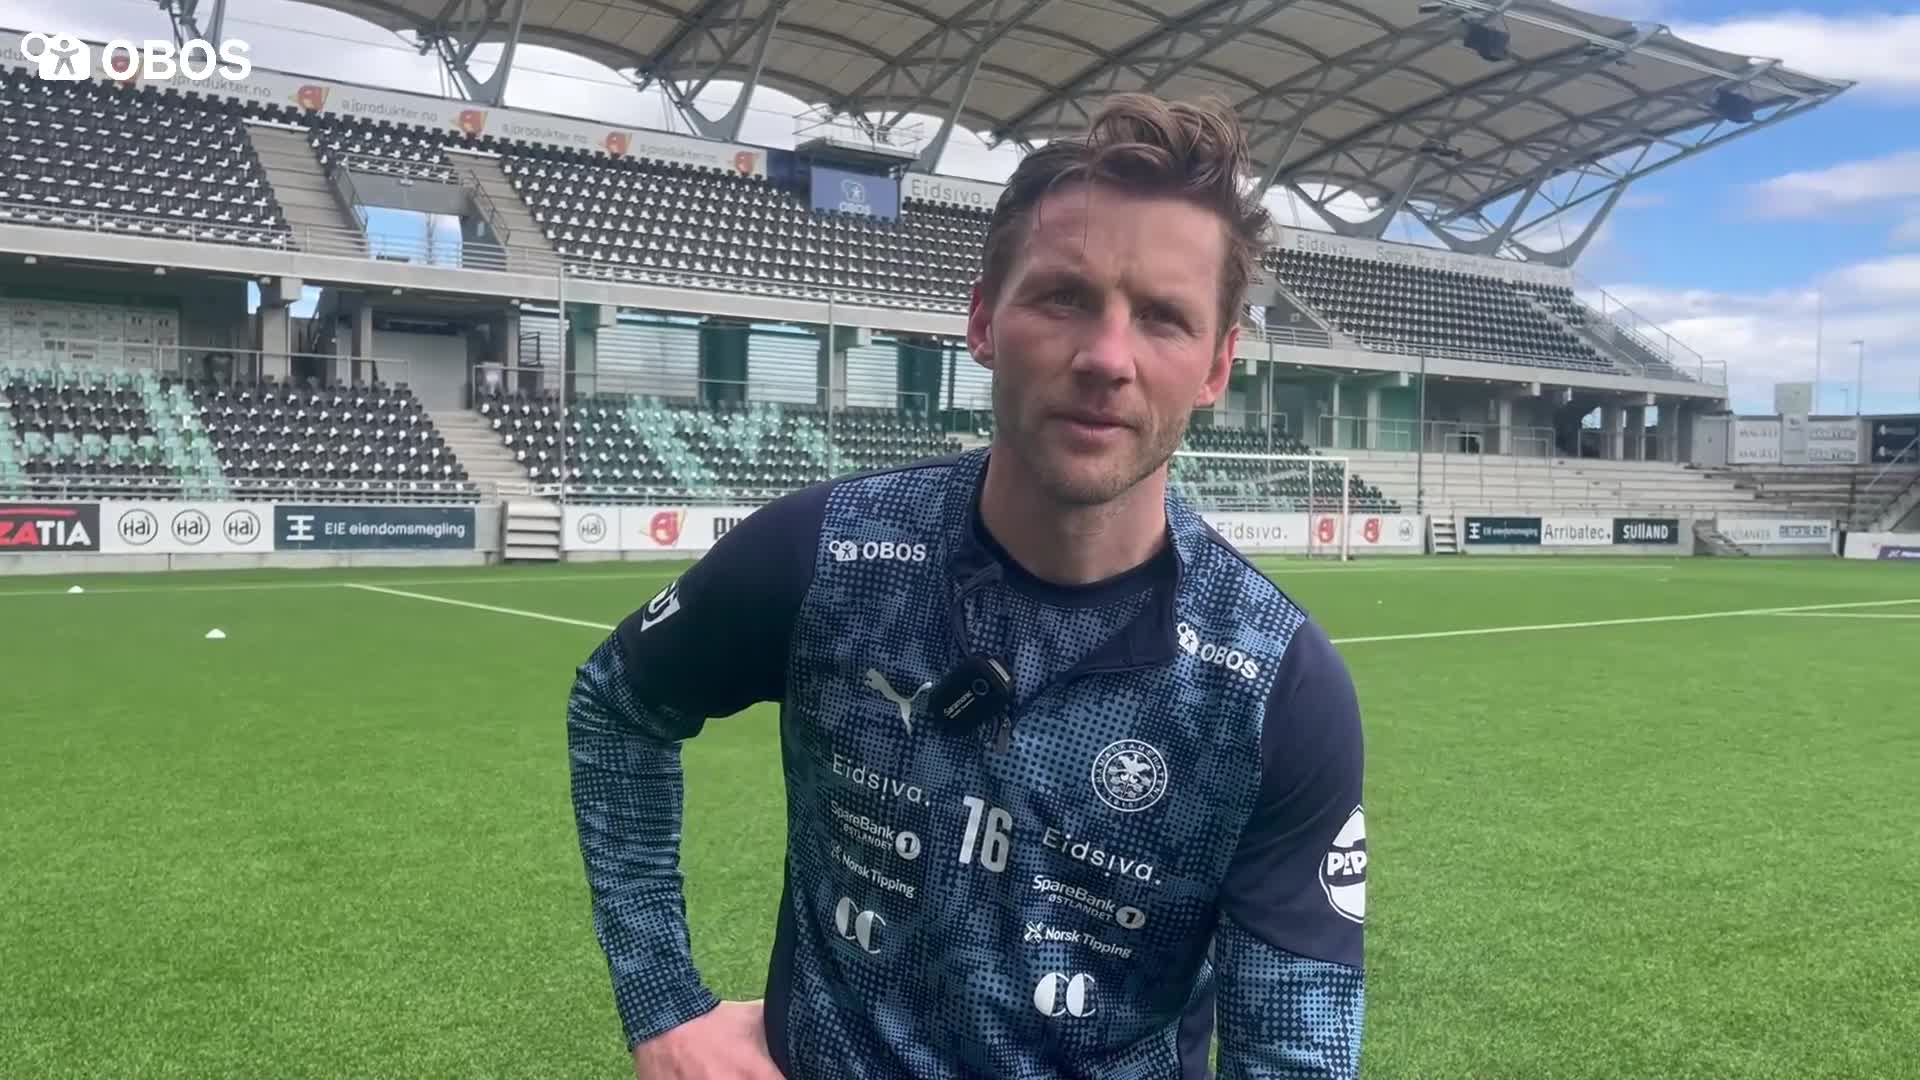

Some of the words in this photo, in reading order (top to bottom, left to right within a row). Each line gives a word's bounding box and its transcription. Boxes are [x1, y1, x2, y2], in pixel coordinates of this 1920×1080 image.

[324, 521, 346, 536] EIE
[349, 521, 466, 539] eiendomsmegling
[863, 541, 927, 561] OBOS
[1200, 643, 1260, 679] OBOS
[830, 800, 896, 841] SpareBank
[958, 795, 1013, 873] 16
[841, 850, 871, 879] Norsk
[869, 868, 915, 899] Tipping
[1032, 874, 1116, 913] SpareBank
[1048, 893, 1114, 921] ØSTLANDET
[1045, 926, 1081, 943] Norsk
[1082, 932, 1134, 960] Tipping
